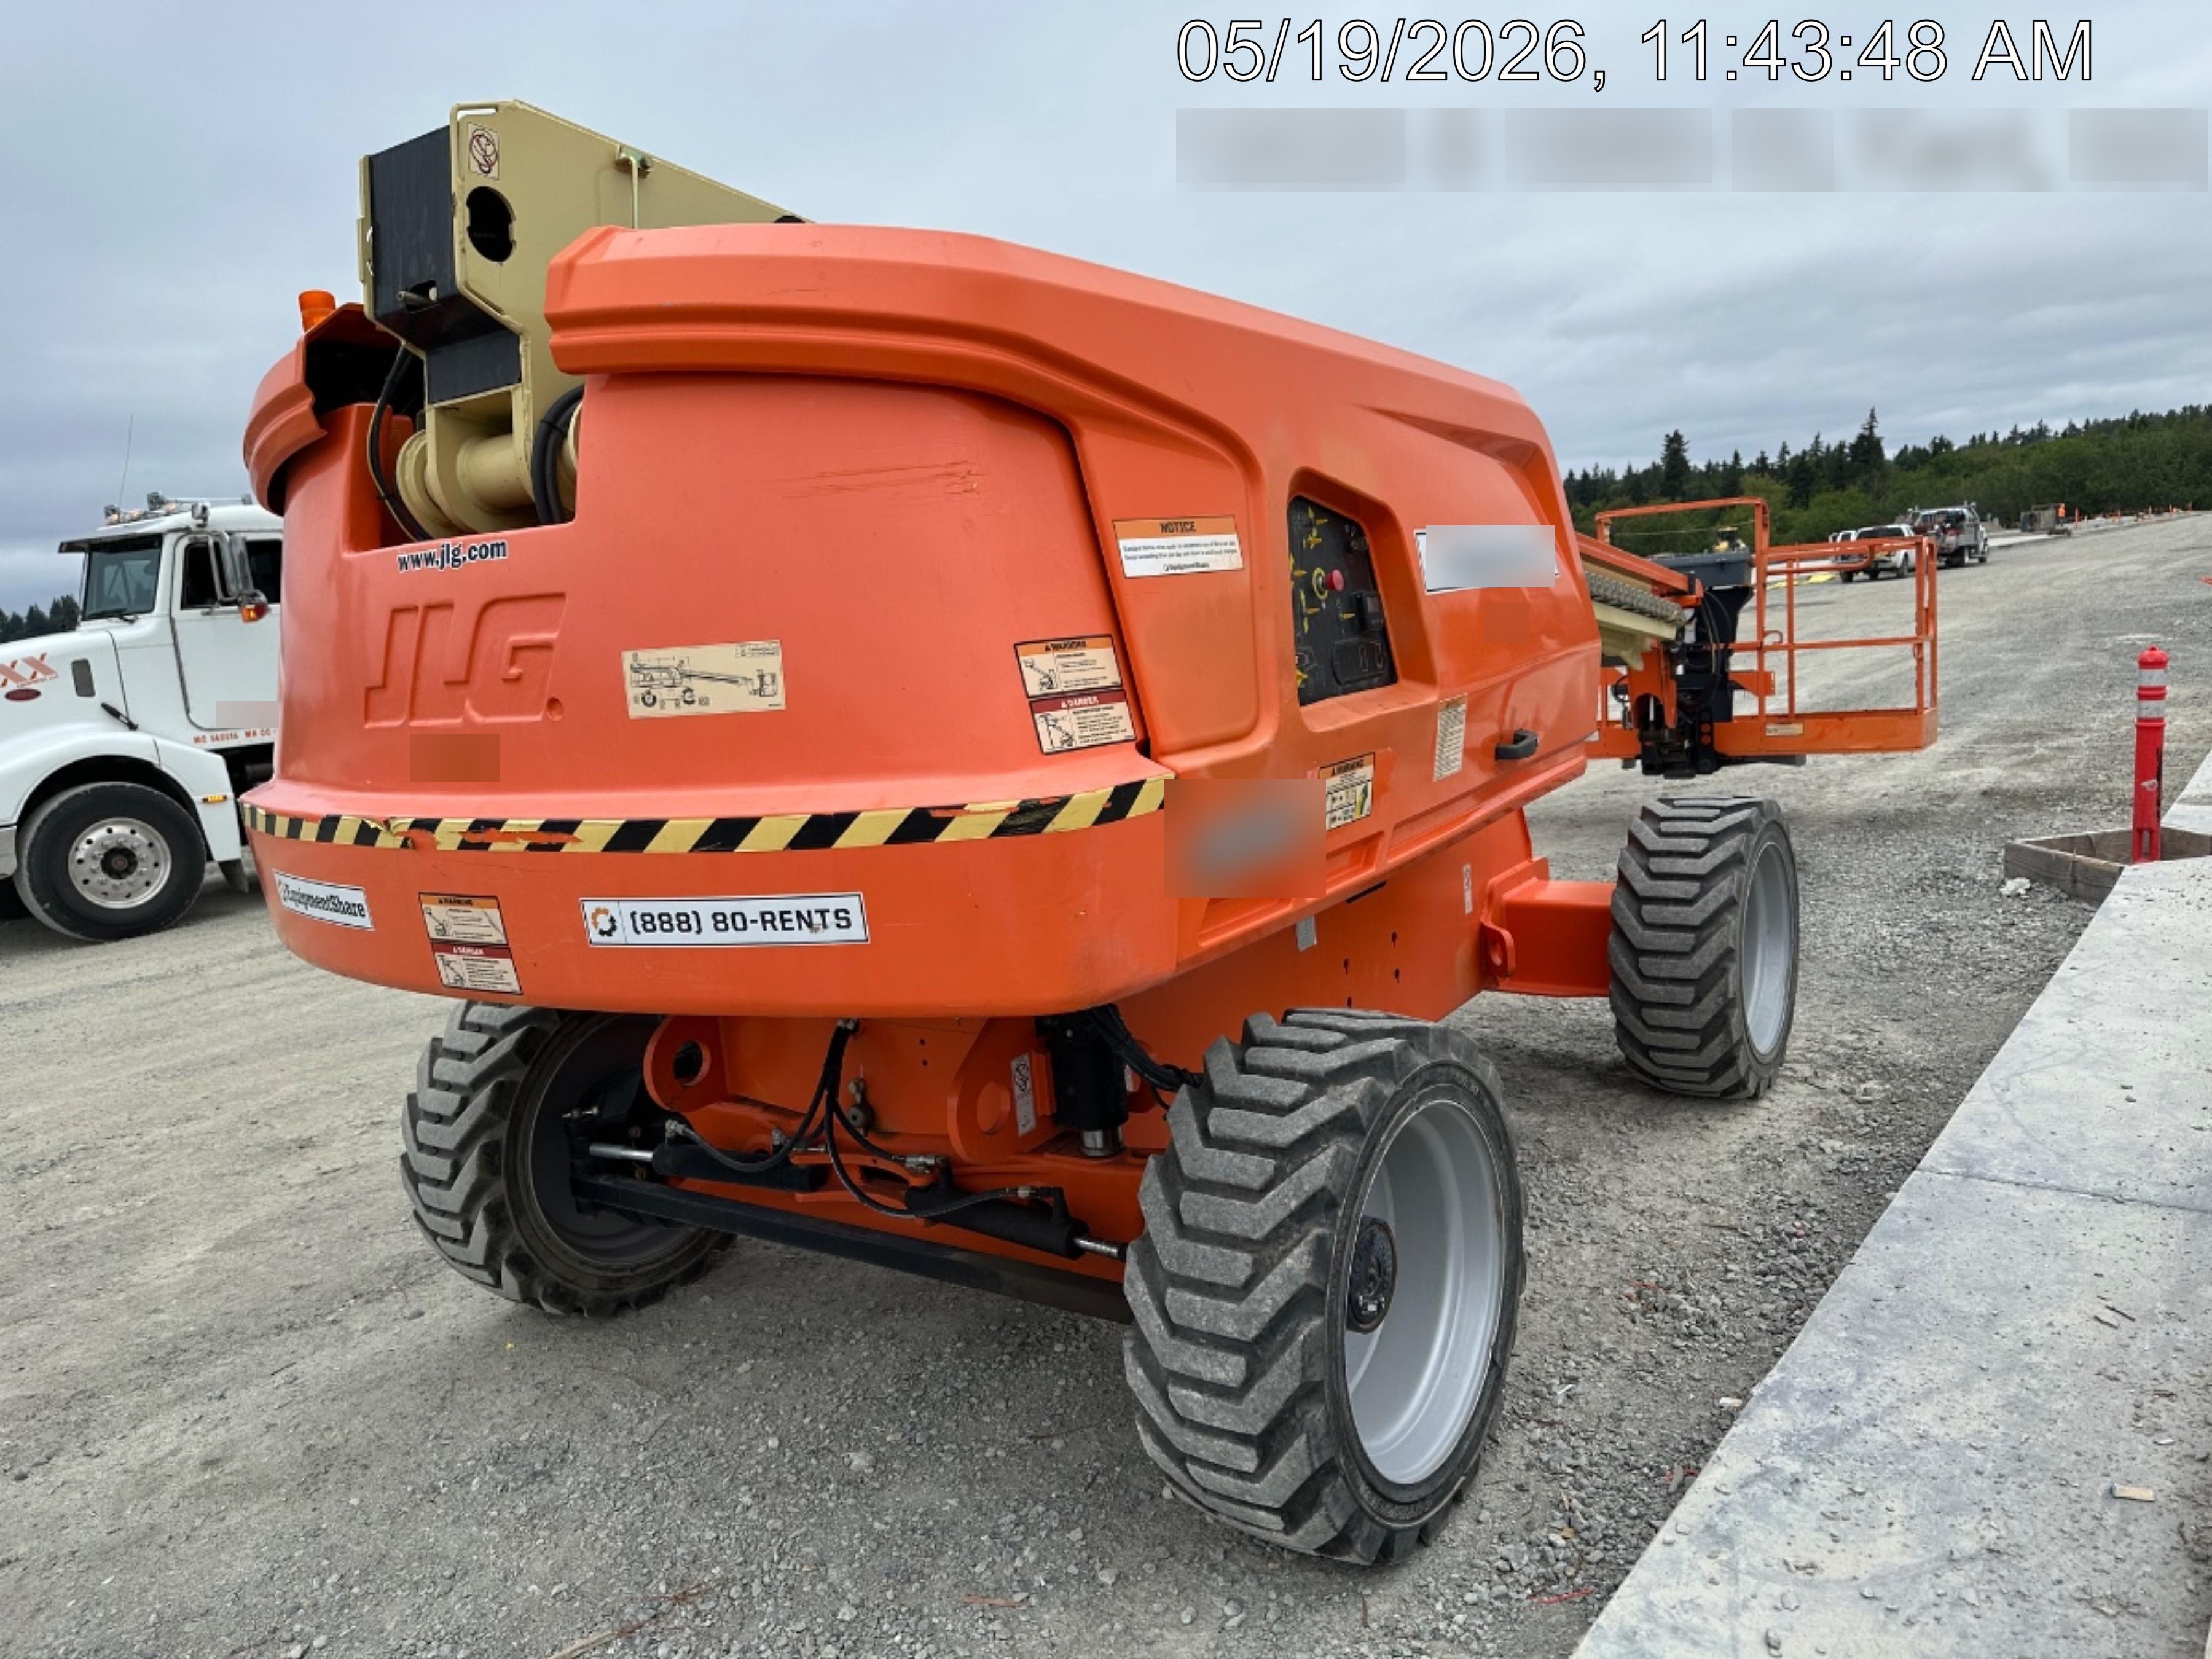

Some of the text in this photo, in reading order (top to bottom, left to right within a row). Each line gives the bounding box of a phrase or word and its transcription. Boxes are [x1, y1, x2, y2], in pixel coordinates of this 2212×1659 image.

[1160, 521, 1196, 533] NOTICE
[398, 541, 508, 571] www.jlg.com
[630, 908, 853, 935] (888) 80-RENTS
